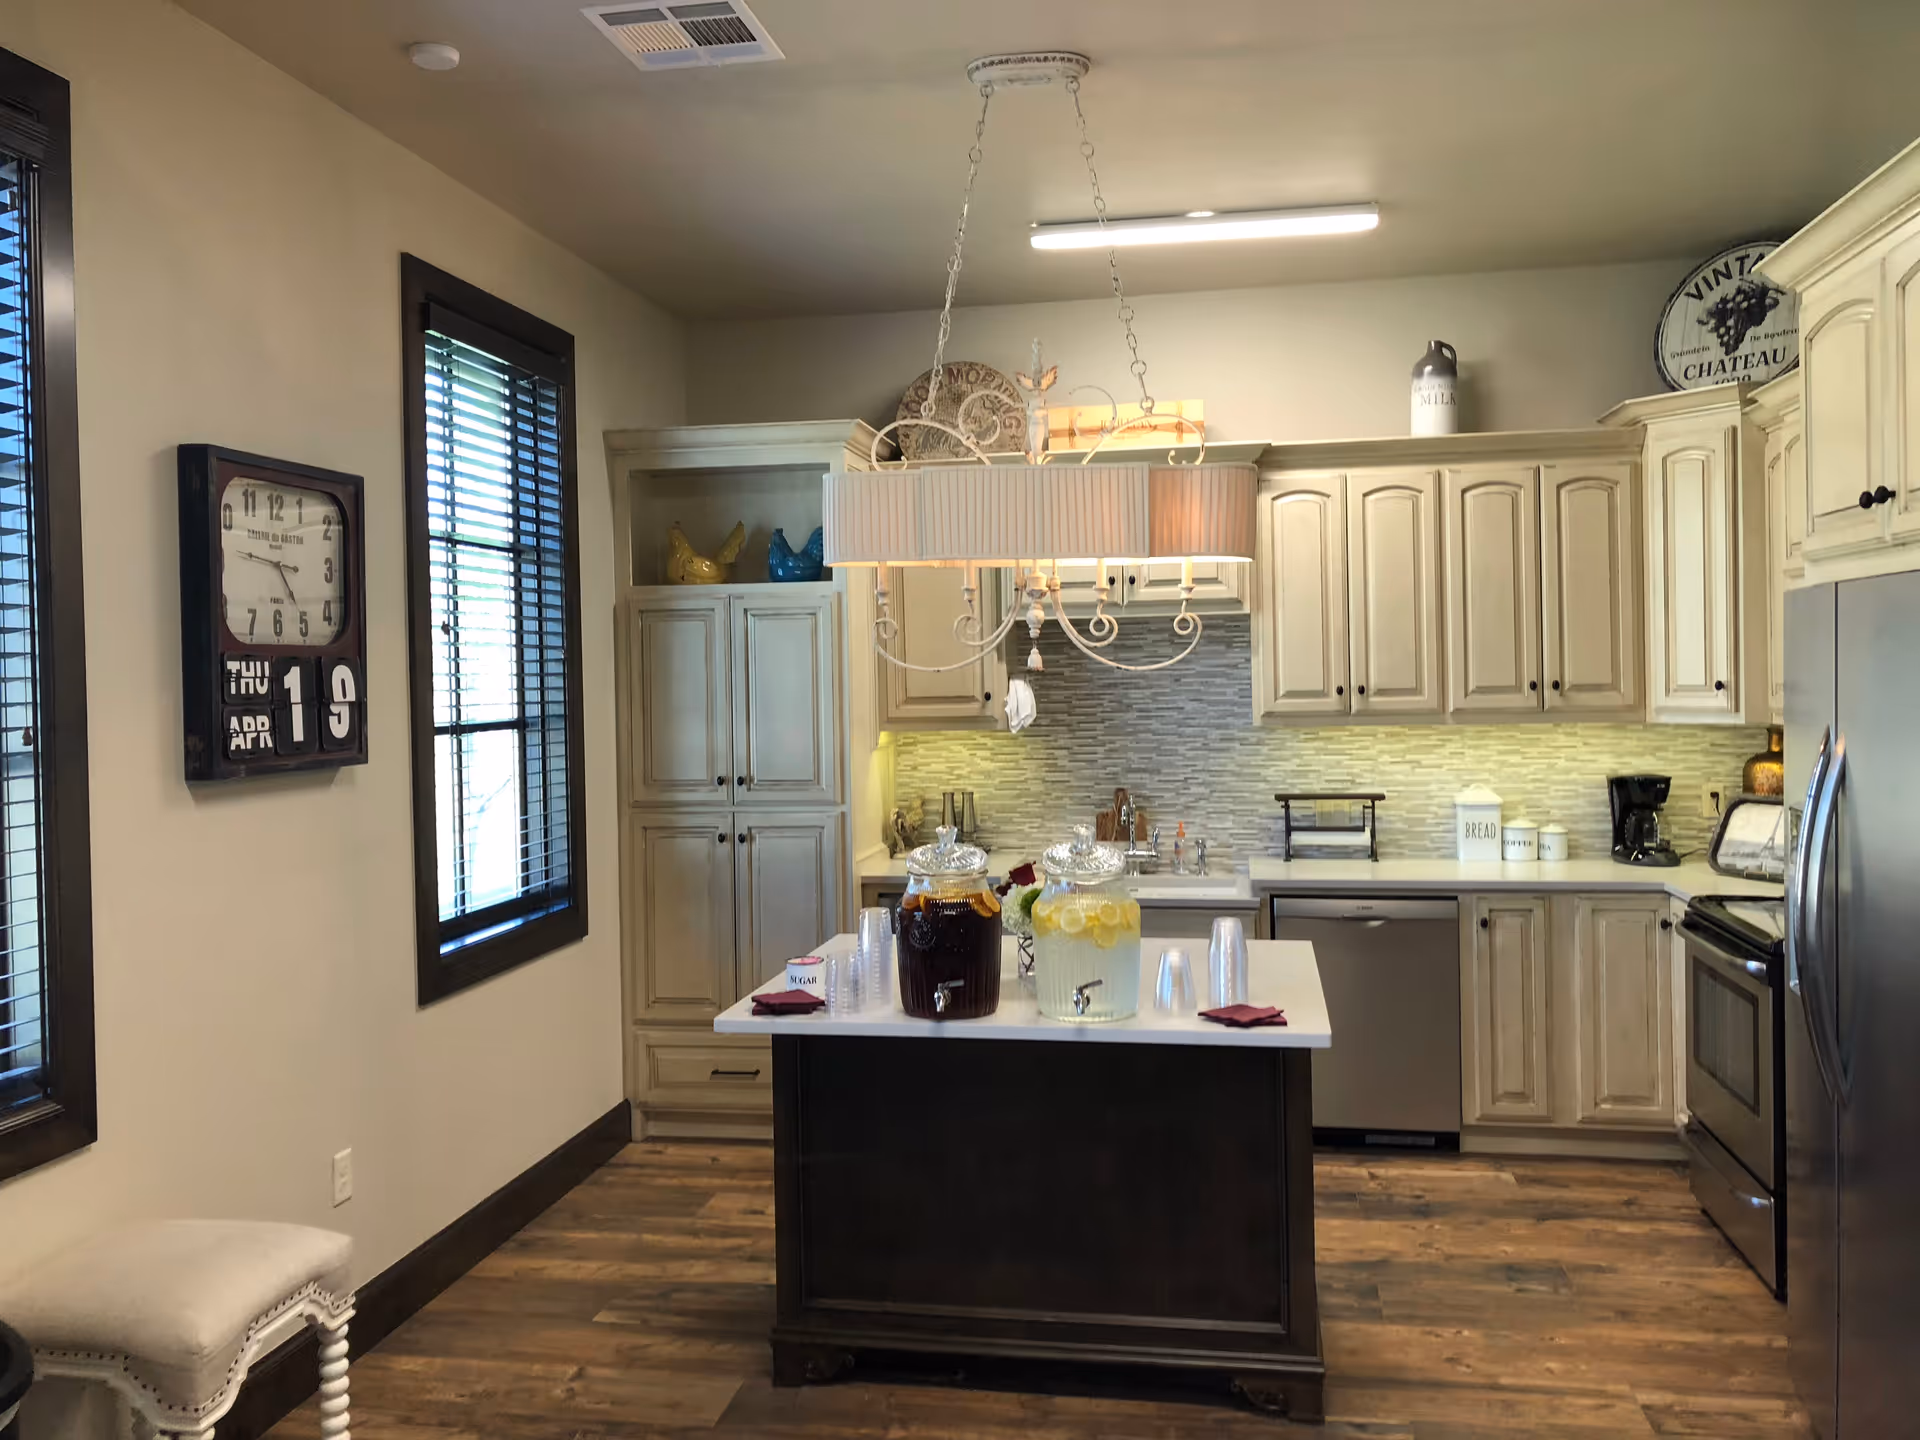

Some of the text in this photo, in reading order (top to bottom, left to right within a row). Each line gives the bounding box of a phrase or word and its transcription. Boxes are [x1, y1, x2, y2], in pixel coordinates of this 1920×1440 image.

[1683, 347, 1786, 381] CHATEAU
[1421, 392, 1456, 406] MILK
[242, 488, 256, 517] 11
[267, 493, 284, 521] 12
[296, 497, 303, 524] 1
[322, 514, 332, 541] 2
[324, 557, 333, 583] 3
[247, 608, 257, 636] 7
[273, 609, 283, 637] 6
[299, 611, 309, 637] 5
[322, 600, 332, 626] 4
[226, 661, 270, 695] THU
[229, 715, 273, 750] APR
[1465, 821, 1496, 840] BREAD
[790, 975, 817, 985] SUGAR
